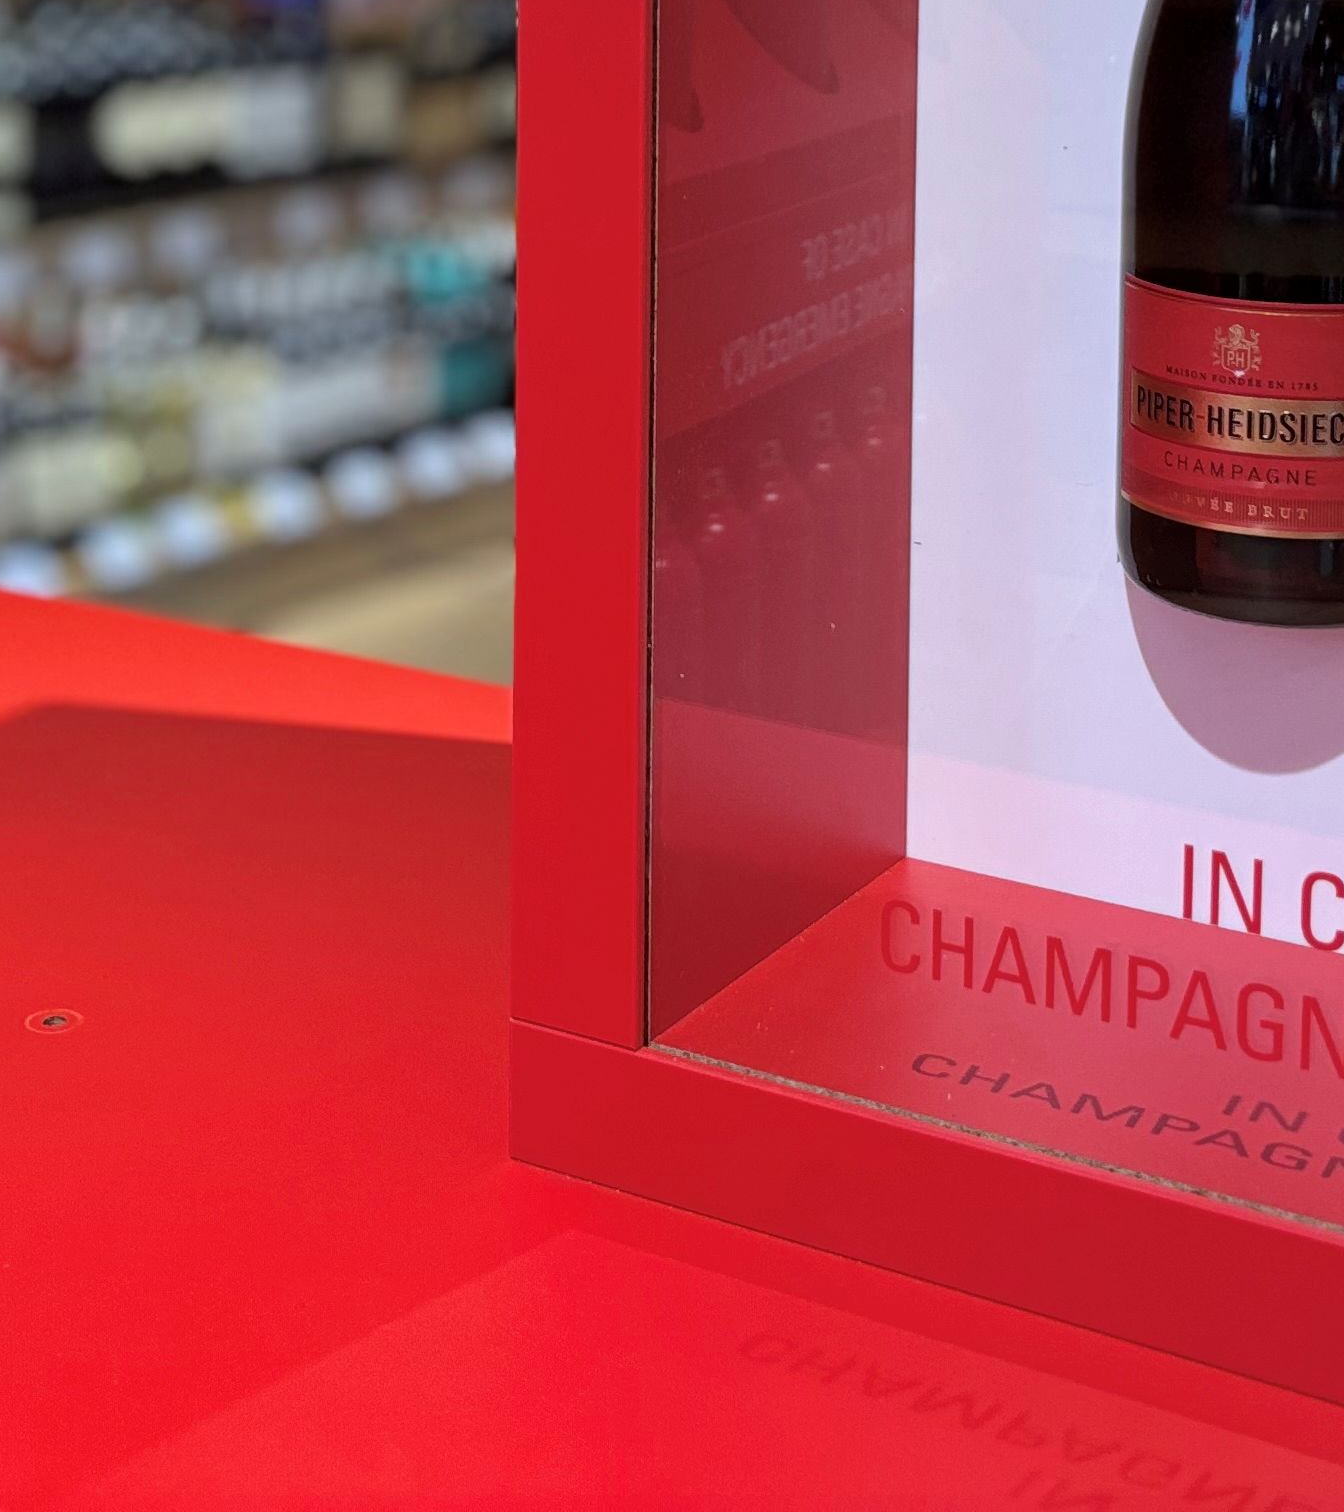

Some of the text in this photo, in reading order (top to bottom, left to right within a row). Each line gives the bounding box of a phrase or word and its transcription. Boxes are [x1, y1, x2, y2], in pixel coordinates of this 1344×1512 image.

[1164, 450, 1319, 487] CHAMPAGNE
[1247, 504, 1309, 521] BRUT
[1182, 843, 1264, 935] IN
